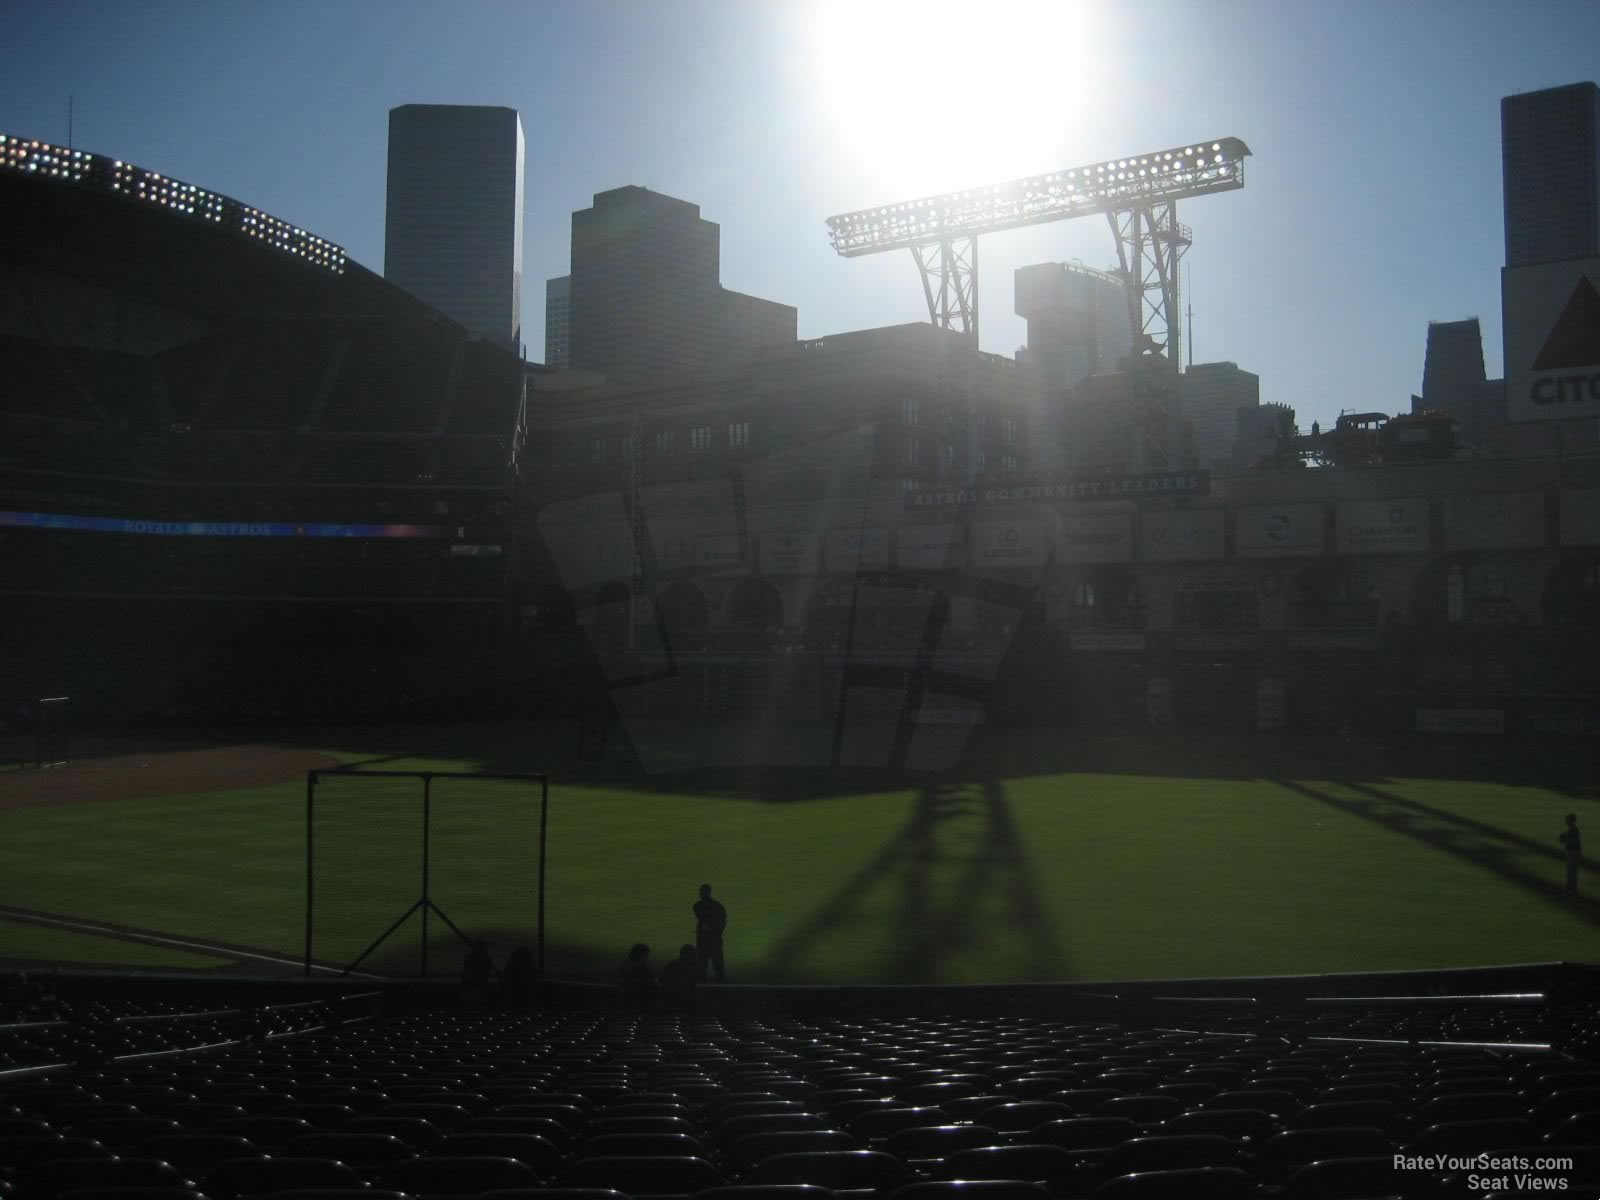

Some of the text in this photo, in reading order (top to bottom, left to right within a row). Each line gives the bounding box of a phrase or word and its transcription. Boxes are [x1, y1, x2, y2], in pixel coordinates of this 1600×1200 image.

[914, 476, 1199, 507] ASTROS COMMUNITY LEADERS
[123, 519, 272, 537] ROYALS ASTROS
